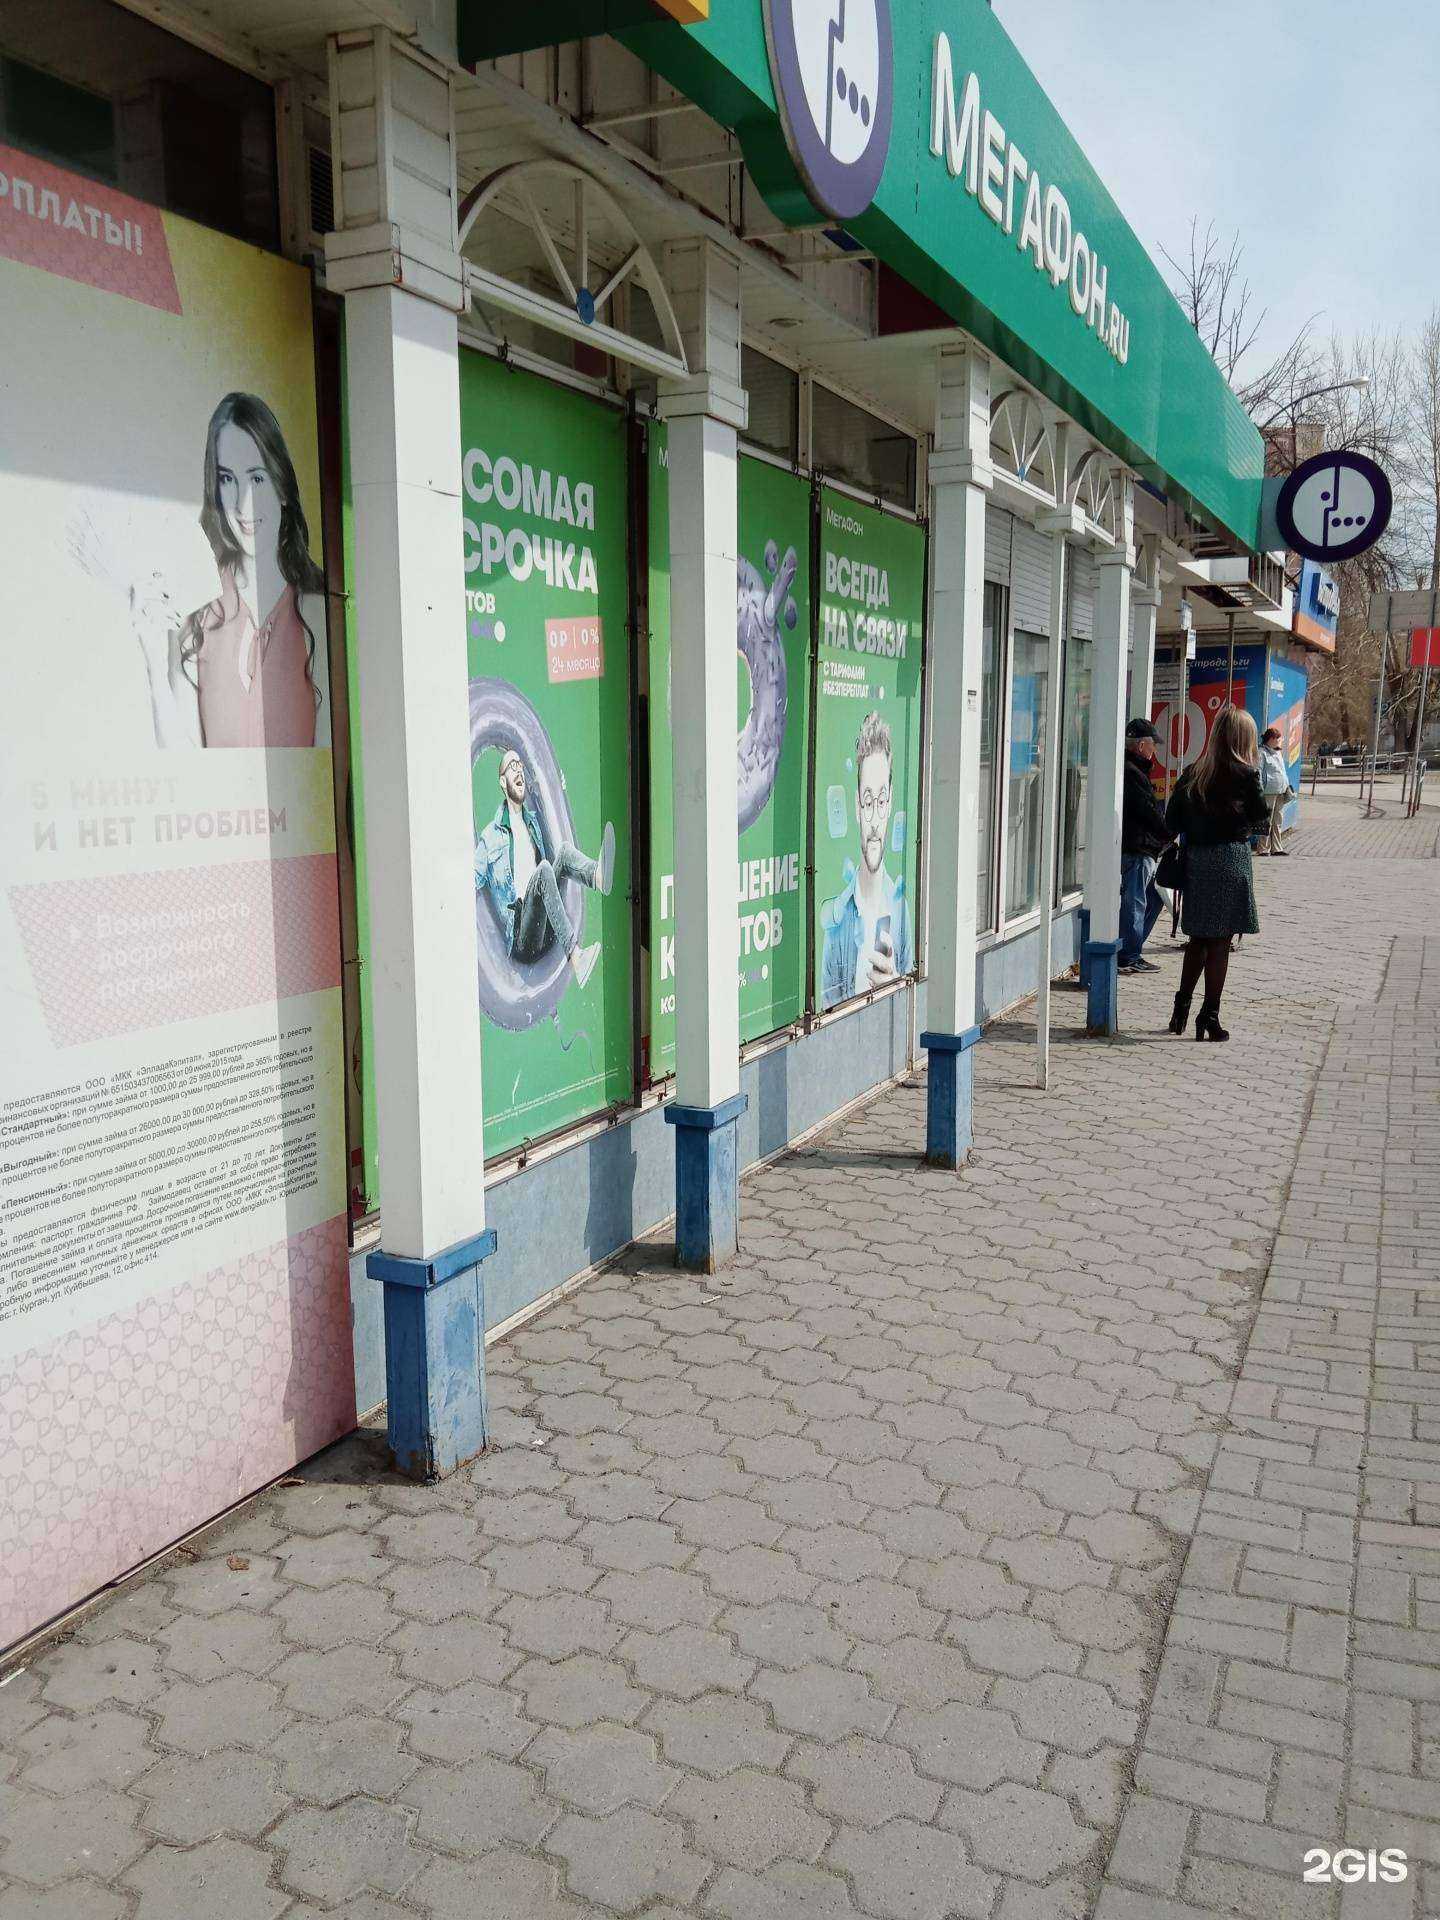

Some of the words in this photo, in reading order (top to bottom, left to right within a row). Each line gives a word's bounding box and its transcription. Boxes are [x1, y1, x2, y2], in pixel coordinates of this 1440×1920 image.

[825, 552, 890, 611] ВСЕГДА
[824, 605, 850, 650] НА
[853, 612, 907, 659] СВЯЗИ
[33, 820, 58, 852] И
[77, 814, 136, 850] НЕТ
[154, 807, 289, 843] ПРОБЛЕМ
